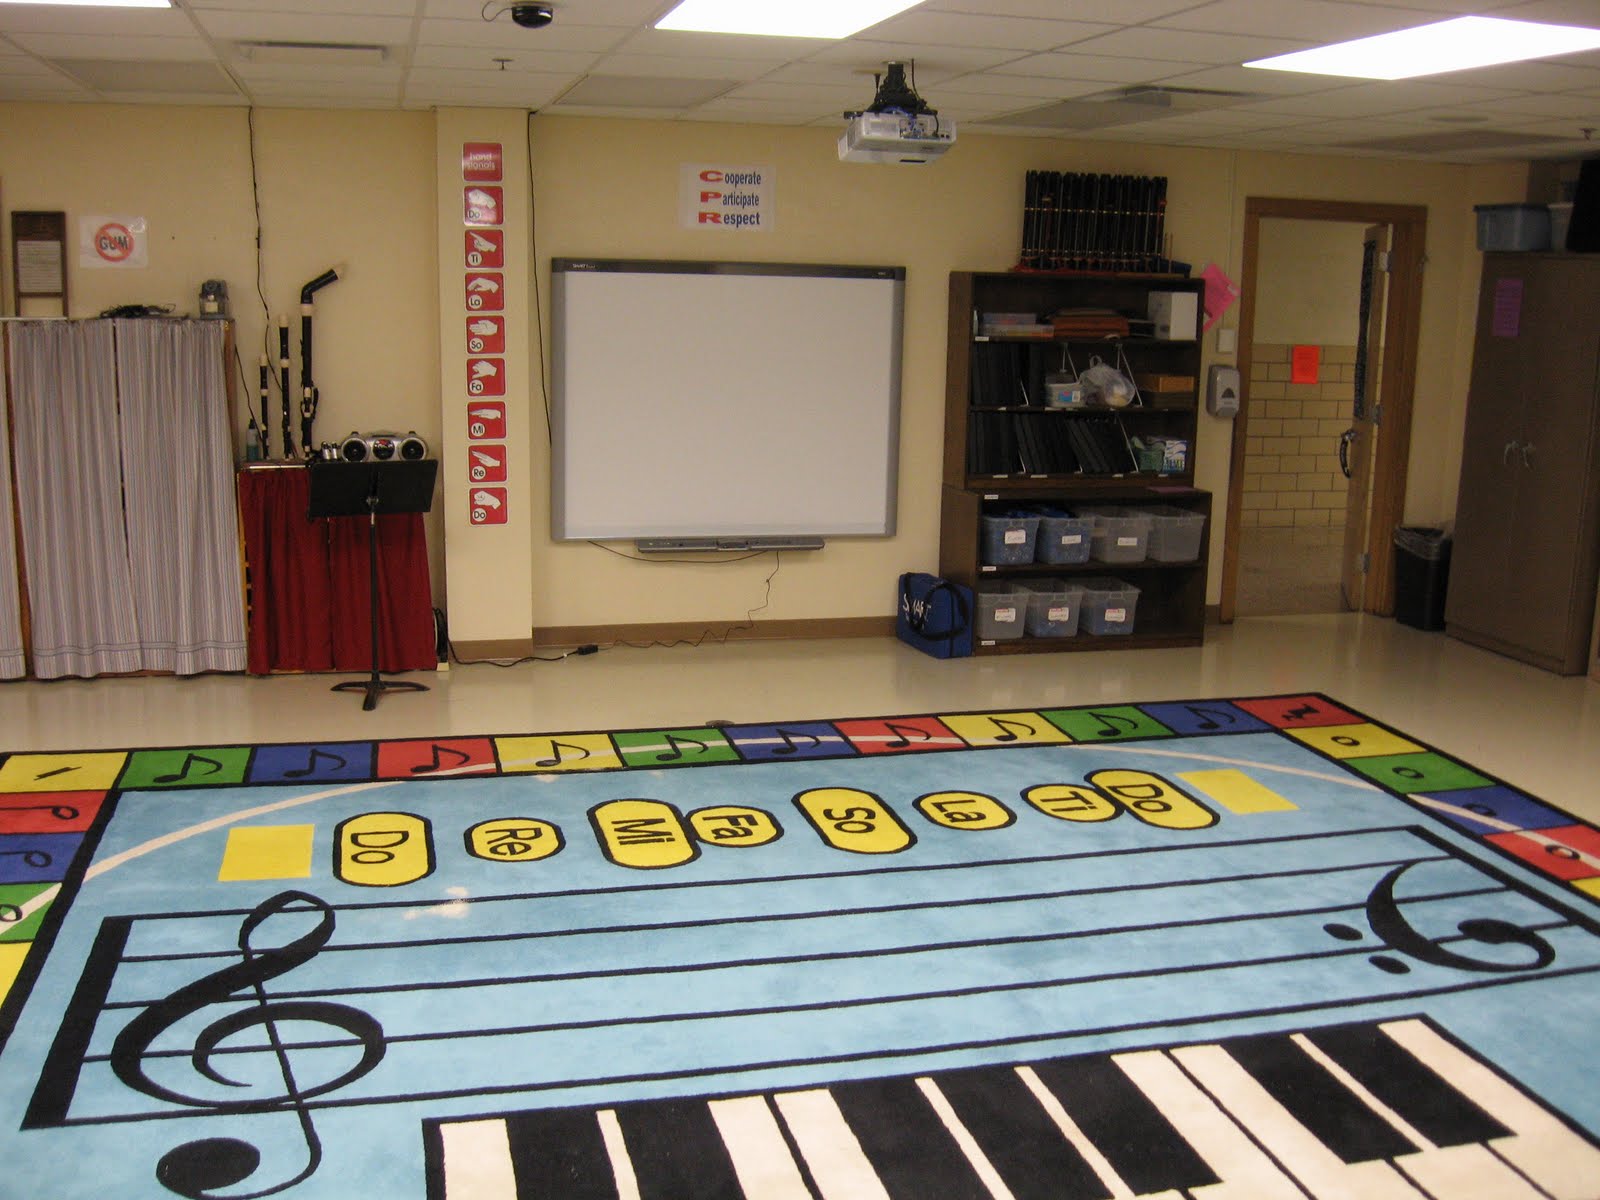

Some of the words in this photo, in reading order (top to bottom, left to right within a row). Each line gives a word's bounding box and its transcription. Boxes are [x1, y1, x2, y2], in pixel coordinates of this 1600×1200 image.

[699, 170, 761, 188] Cooperate
[700, 191, 760, 209] Participate
[468, 210, 481, 219] Do
[698, 211, 761, 228] Respect
[99, 236, 129, 250] GUM
[471, 254, 479, 263] Ti
[470, 298, 480, 306] La
[471, 340, 482, 349] So
[471, 382, 481, 391] Fa
[472, 425, 483, 434] Mi
[473, 468, 484, 477] Re
[473, 510, 486, 519] Do
[1040, 791, 1097, 812] Ti
[1107, 783, 1172, 812] Do
[931, 799, 986, 823] La
[702, 813, 759, 841] Fa
[823, 806, 877, 834] So
[611, 817, 676, 846] Mi
[351, 830, 410, 864] Do
[485, 827, 543, 856] Re
